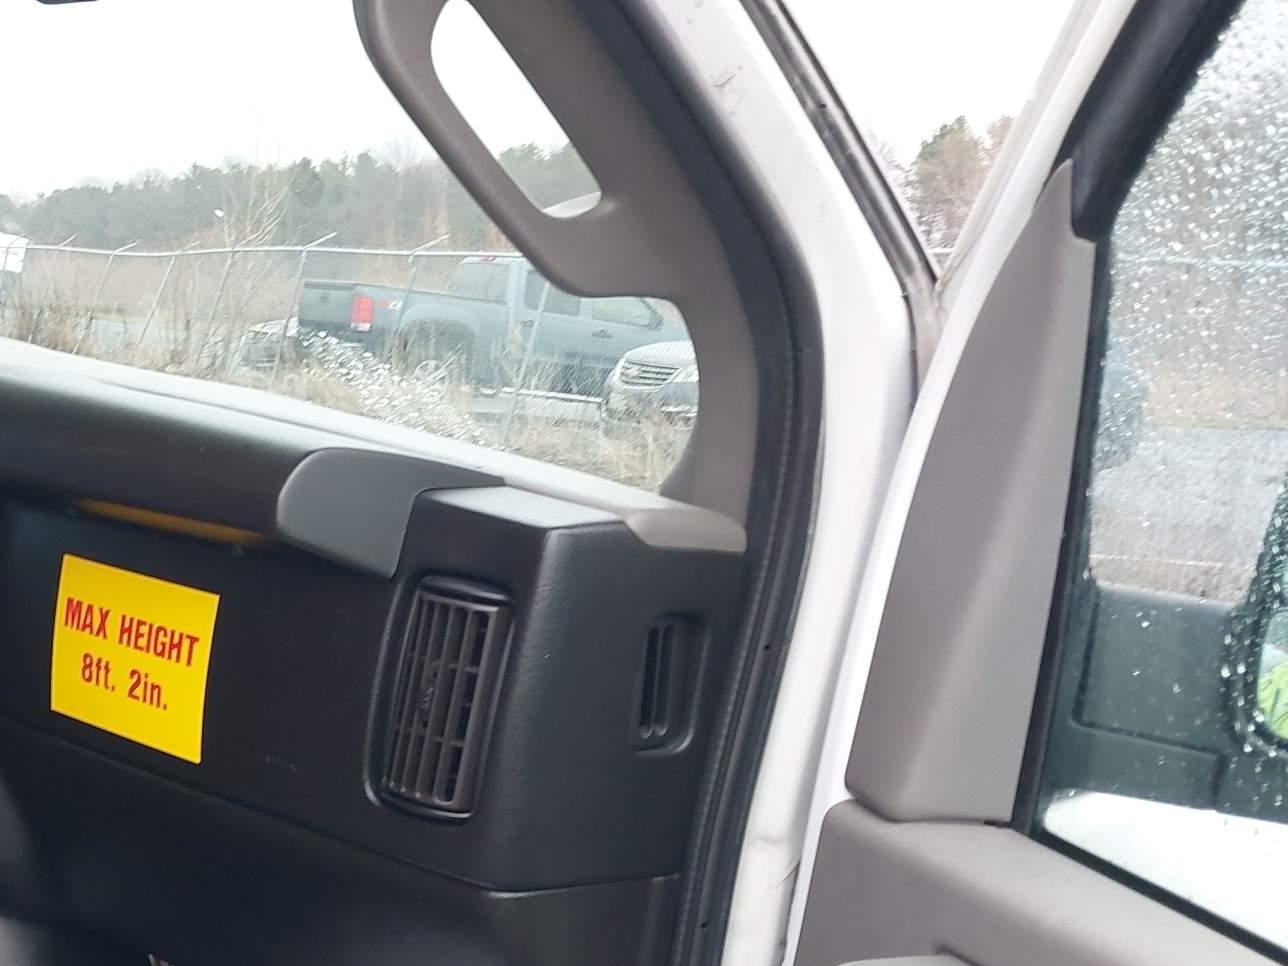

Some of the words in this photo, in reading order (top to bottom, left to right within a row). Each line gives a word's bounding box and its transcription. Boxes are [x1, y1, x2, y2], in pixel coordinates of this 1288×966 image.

[64, 597, 111, 640] MAX
[118, 614, 200, 667] HEIGHT
[81, 653, 115, 692] 8ft.
[127, 669, 168, 710] 2in.
